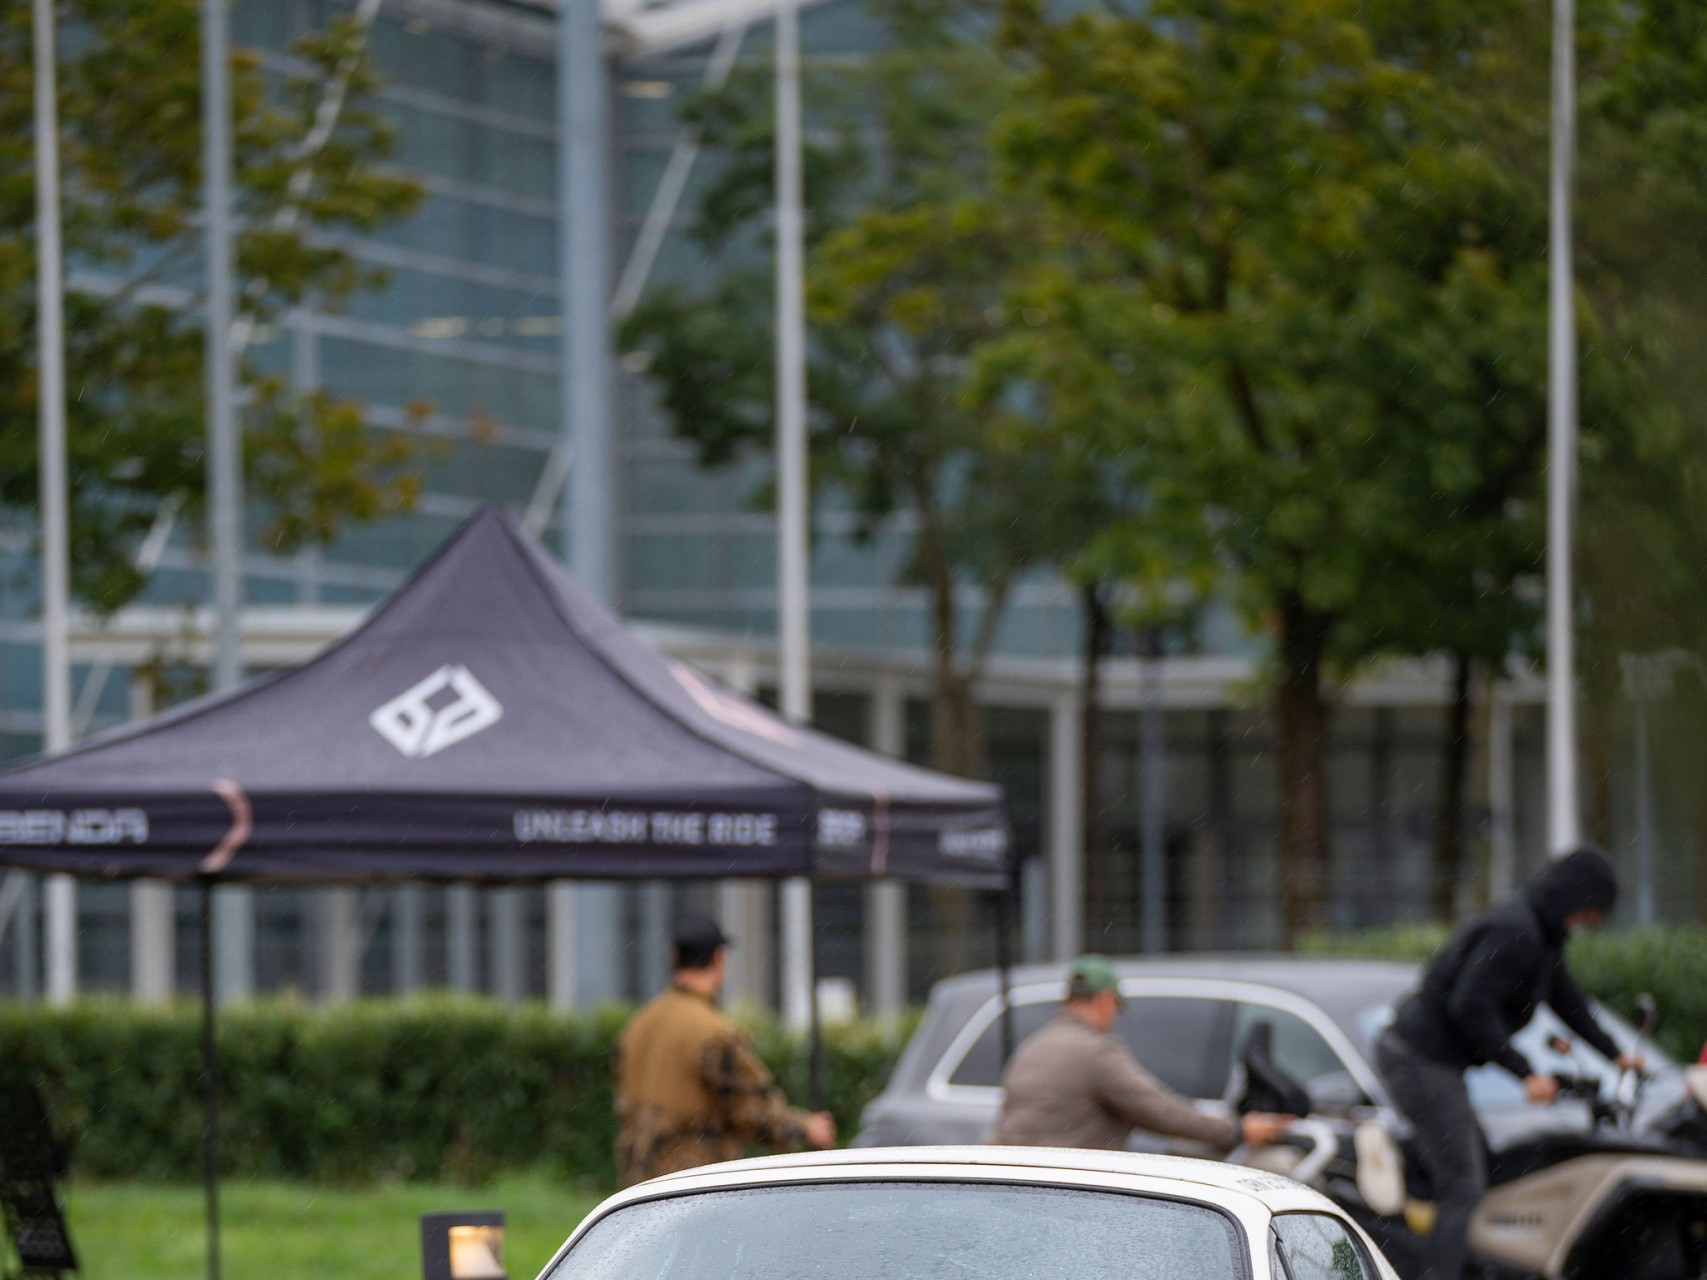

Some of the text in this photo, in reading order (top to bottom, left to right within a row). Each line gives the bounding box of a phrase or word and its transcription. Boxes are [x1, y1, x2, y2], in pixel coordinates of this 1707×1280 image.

[513, 809, 647, 843] UNLEASH
[651, 811, 705, 845] THE
[707, 812, 778, 846] RIDE
